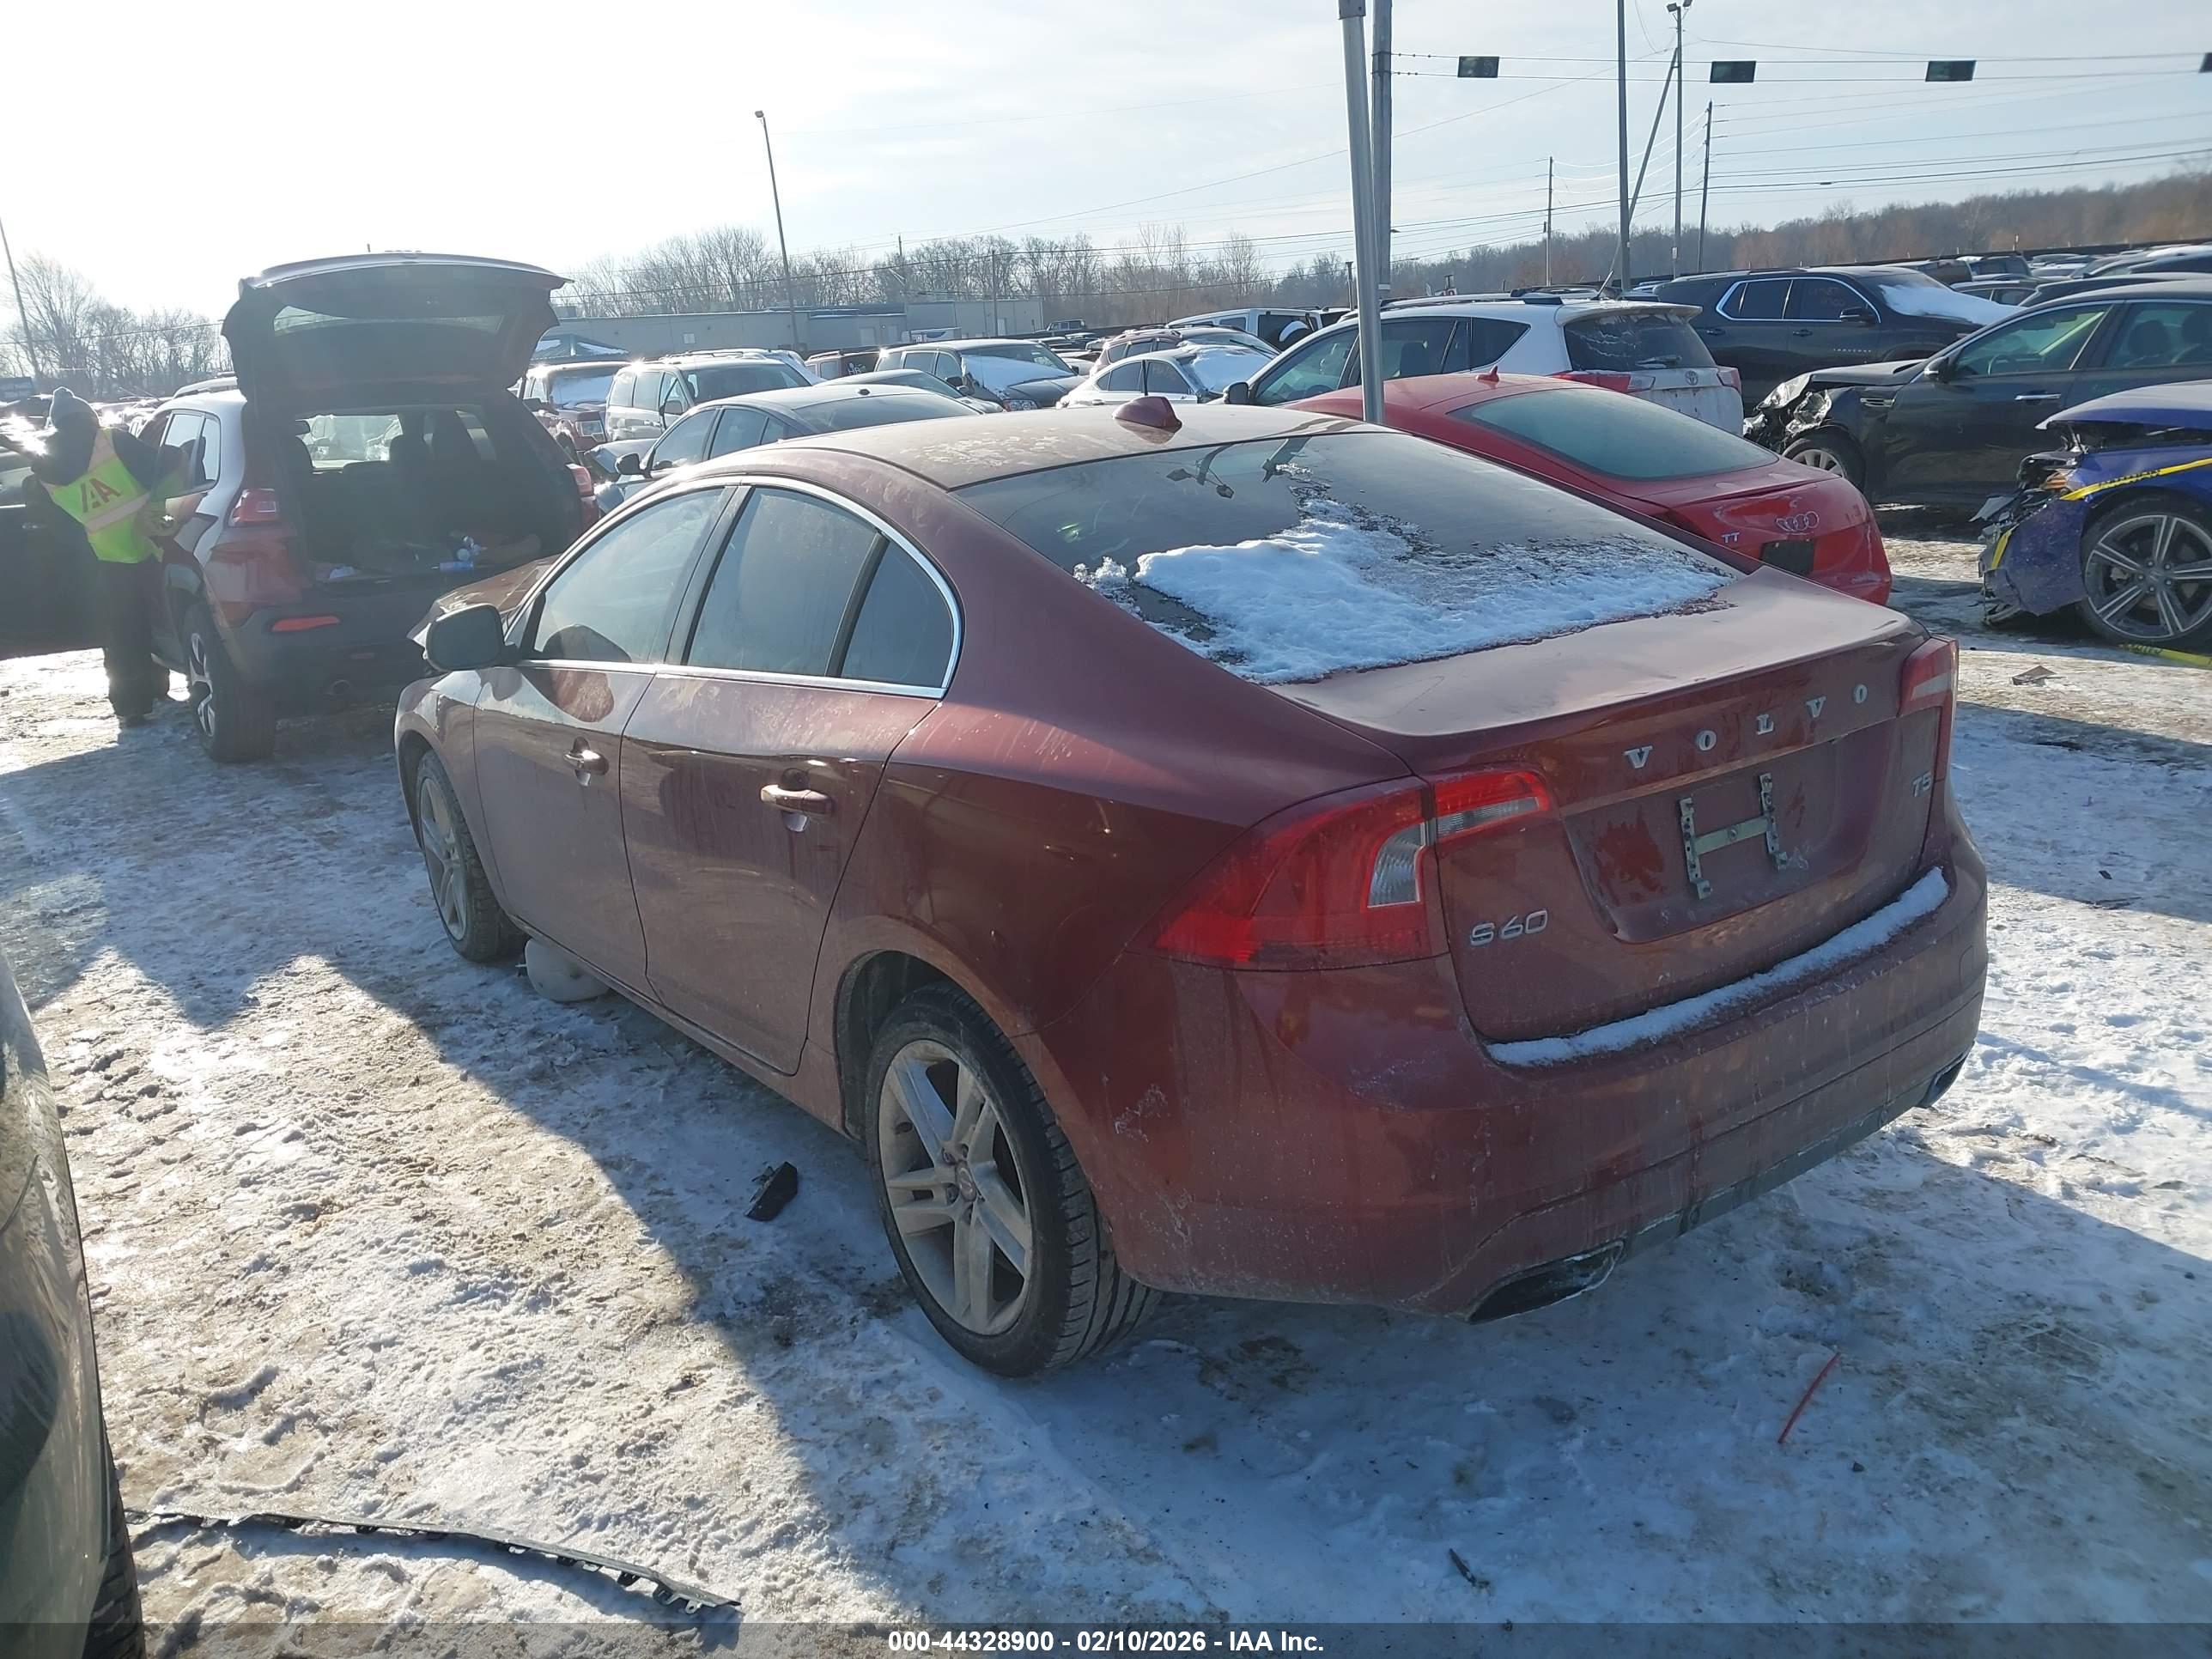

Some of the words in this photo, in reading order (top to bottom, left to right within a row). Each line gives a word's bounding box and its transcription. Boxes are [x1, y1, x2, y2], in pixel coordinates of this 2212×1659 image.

[1721, 532, 1740, 544] TT
[1624, 684, 1869, 769] VOLVO
[1470, 908, 1548, 946] S60
